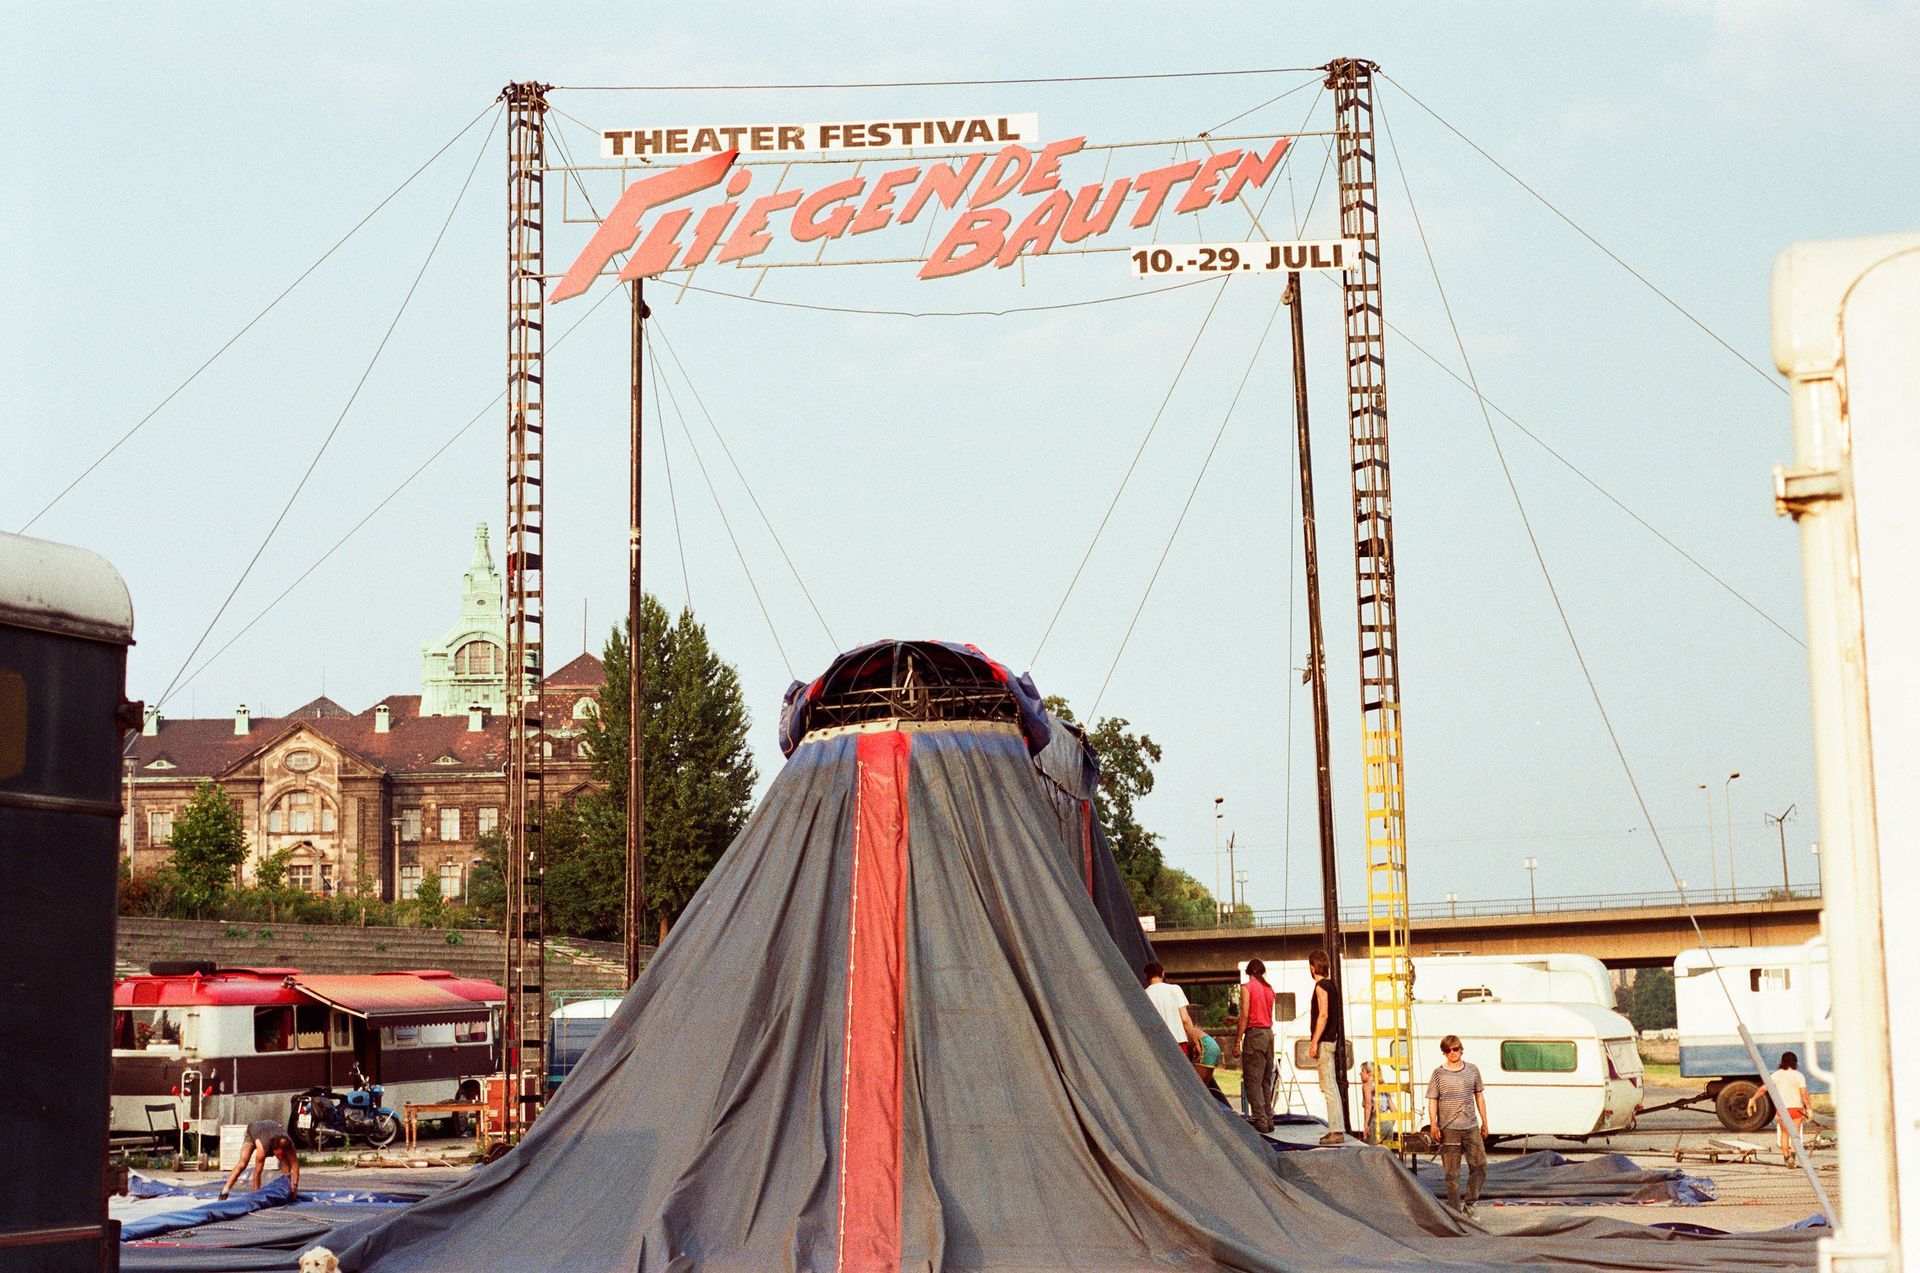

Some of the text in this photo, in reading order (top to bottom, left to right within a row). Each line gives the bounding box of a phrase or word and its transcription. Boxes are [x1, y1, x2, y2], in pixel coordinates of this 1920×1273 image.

[604, 118, 1020, 156] THEATER FESTIVAL
[917, 138, 1292, 280] BAUTEN
[1132, 244, 1344, 274] 10.-29. JULI
